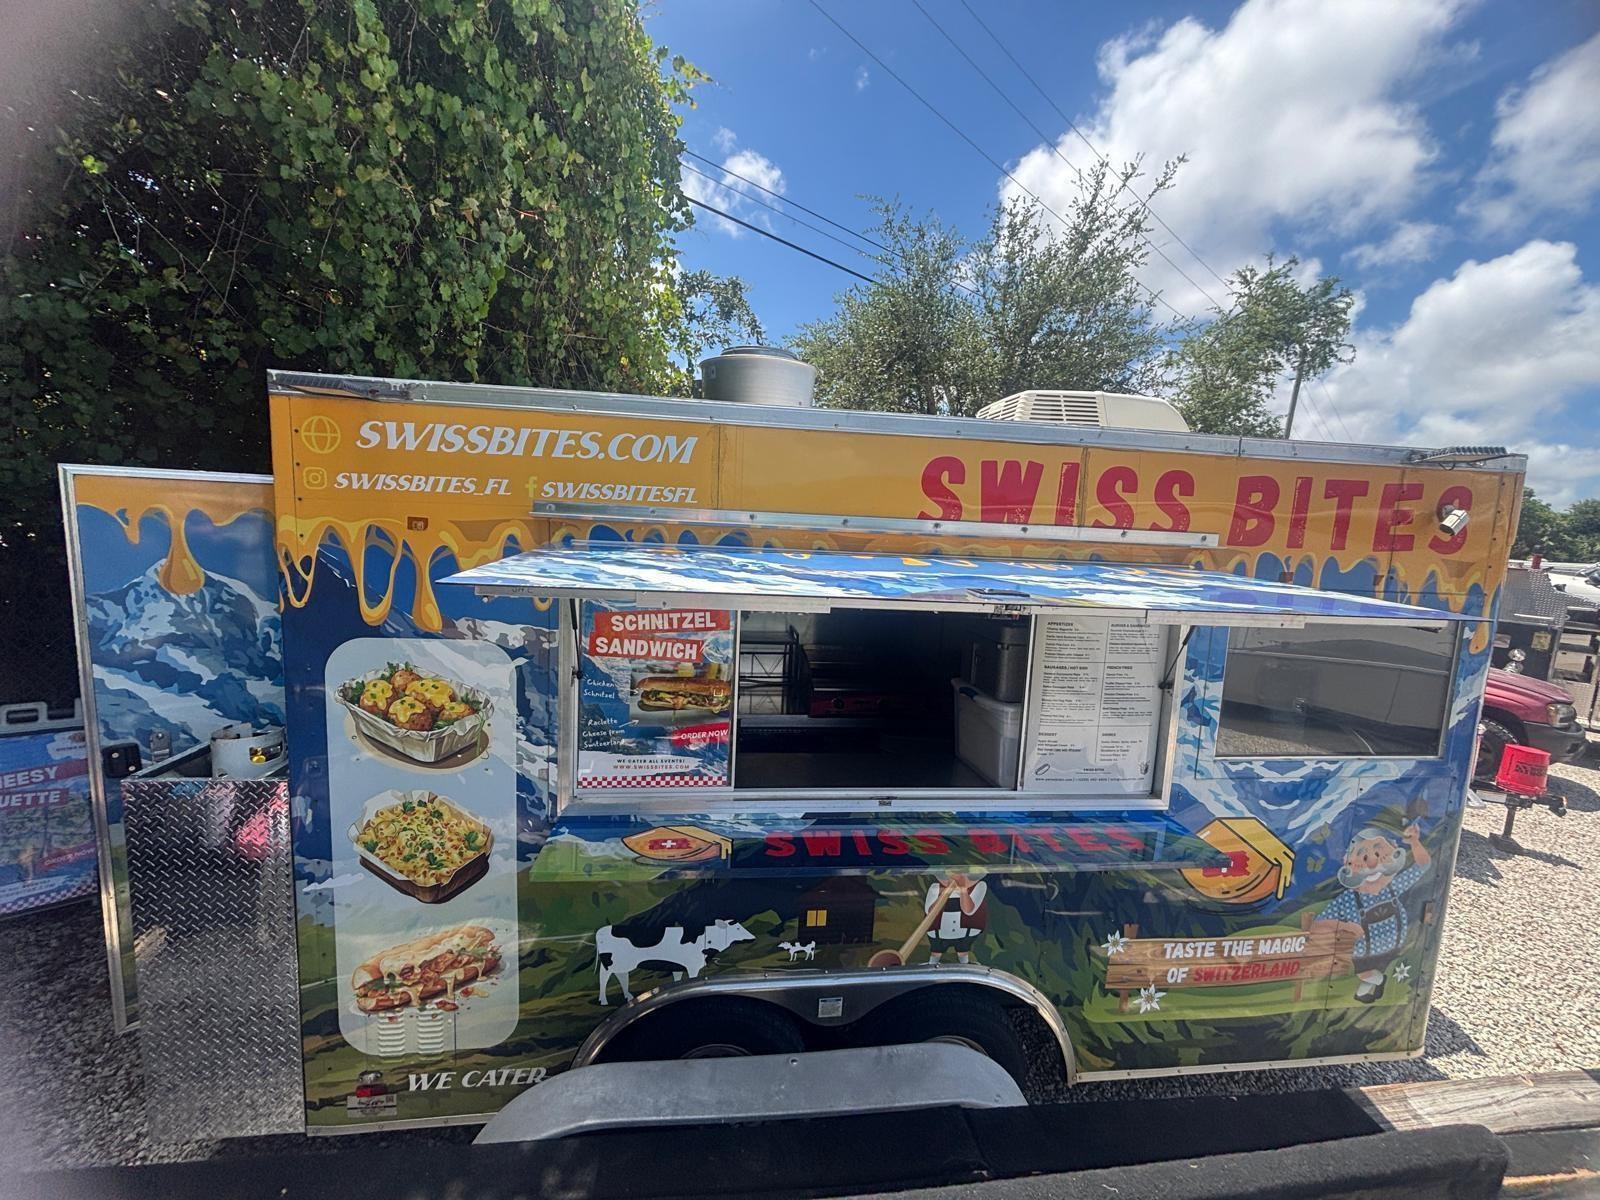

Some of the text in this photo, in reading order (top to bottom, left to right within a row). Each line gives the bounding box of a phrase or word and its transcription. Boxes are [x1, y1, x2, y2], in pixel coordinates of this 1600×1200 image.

[356, 421, 698, 464] SWISSBITES.COM
[334, 472, 511, 496] SWISSBITES_FL
[541, 481, 698, 504] SWISSBITESFL
[917, 455, 1474, 555] SWISS BITES
[611, 611, 716, 632] SCHNITZEL
[595, 637, 698, 660] SANDWICH
[586, 678, 615, 688] Chicken
[680, 728, 729, 740] ORDER NOW
[0, 766, 58, 789] EESY
[764, 827, 1147, 857] SWISS BITES
[1163, 936, 1306, 959] TASTE THE MAGIC
[1166, 960, 1301, 983] OF SWITZERLAND
[407, 1066, 553, 1092] WE CATER
